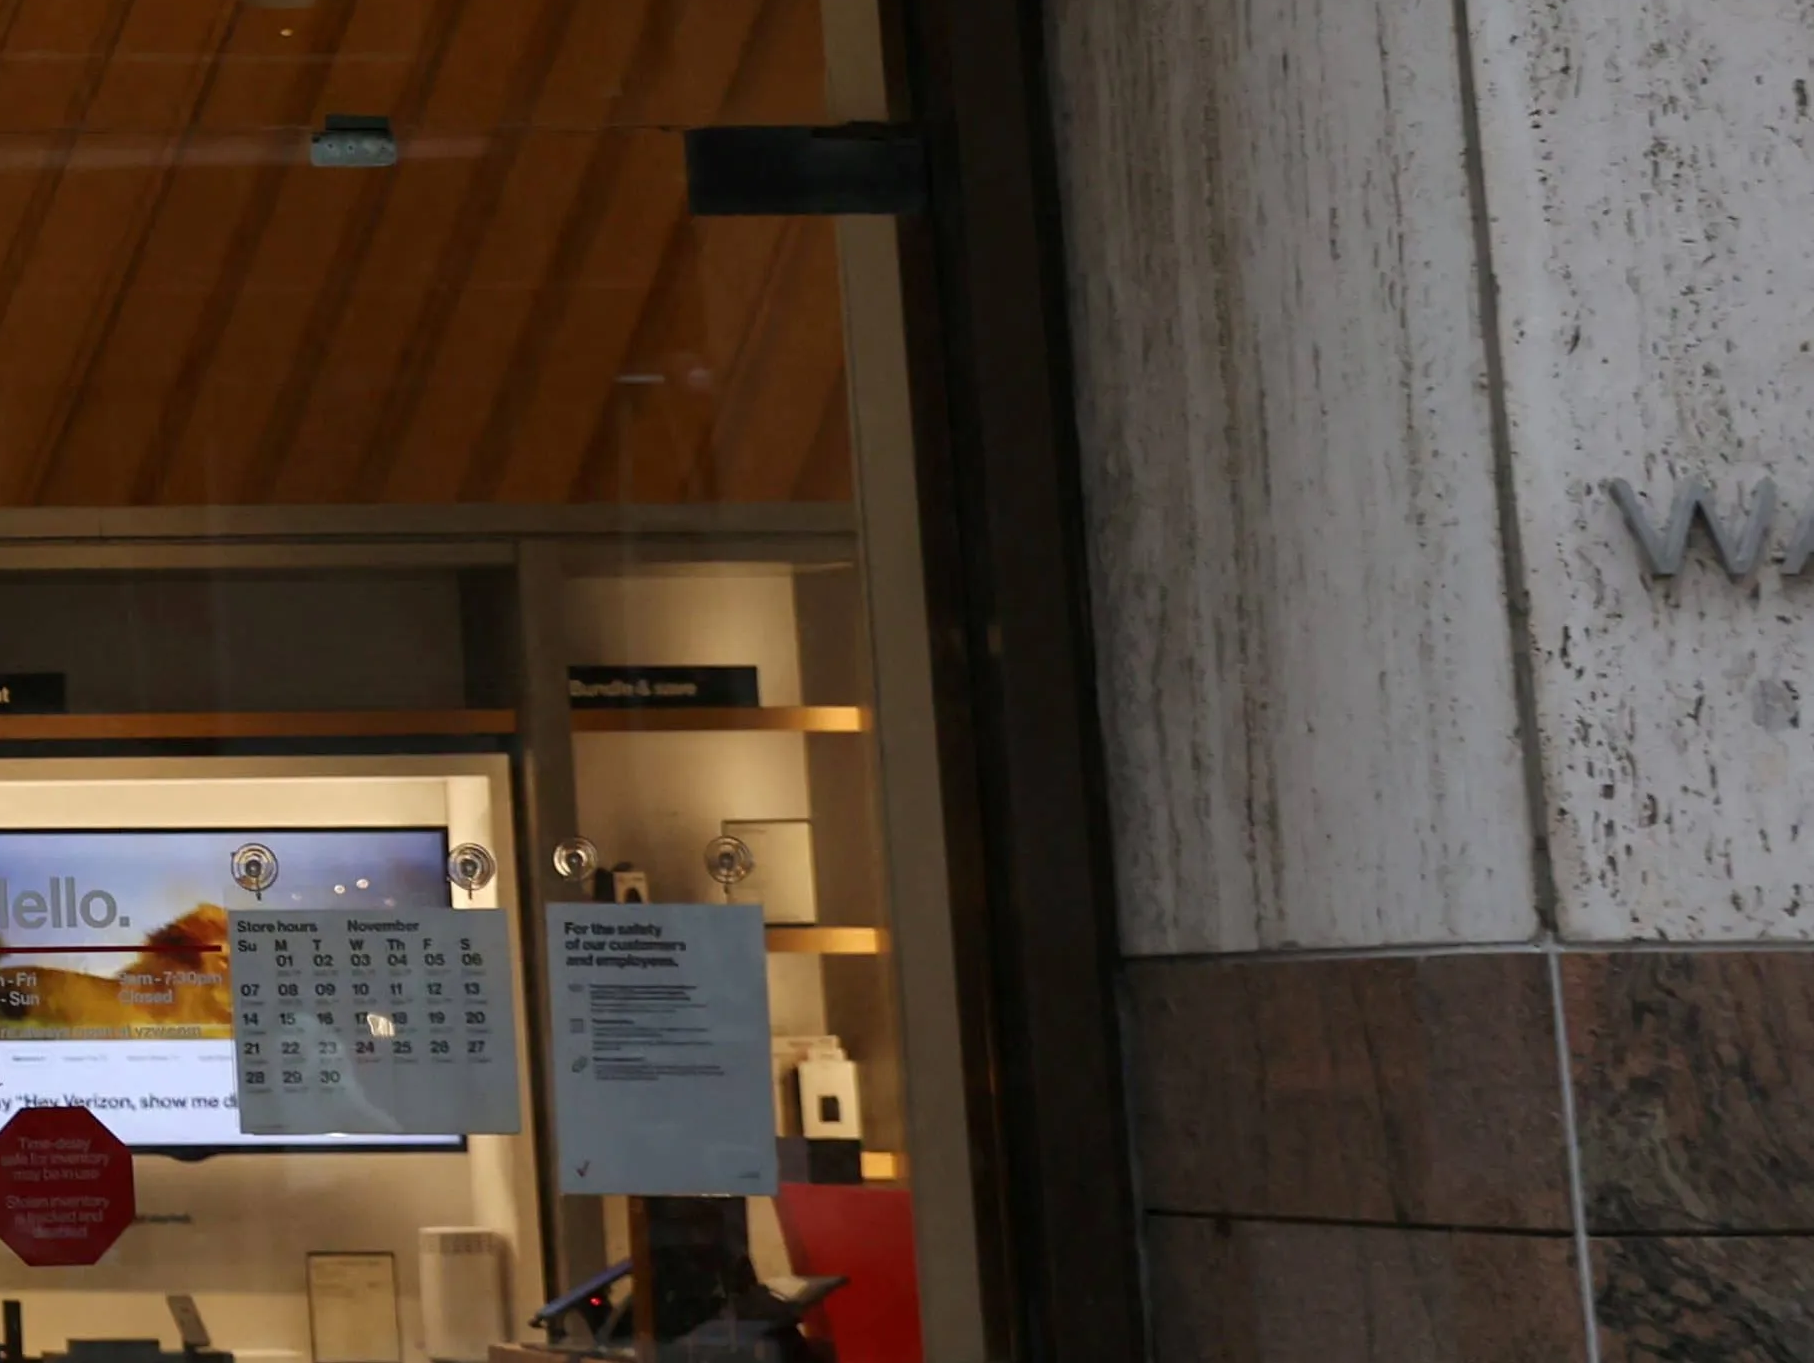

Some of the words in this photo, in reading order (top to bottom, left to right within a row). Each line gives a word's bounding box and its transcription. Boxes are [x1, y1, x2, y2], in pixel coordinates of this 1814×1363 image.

[236, 920, 275, 933] Store
[277, 920, 318, 933] hours
[347, 920, 420, 933] November
[564, 922, 590, 936] For
[591, 922, 615, 936] the
[618, 923, 662, 938] safety
[237, 939, 257, 952] Su
[275, 939, 288, 952] M
[312, 939, 322, 952] T
[349, 939, 364, 952] W
[386, 939, 406, 952] Th
[423, 939, 433, 952] F
[460, 939, 471, 952] S
[565, 938, 580, 951] of
[583, 941, 606, 951] our
[609, 939, 686, 952] customers
[276, 954, 294, 967] 01
[313, 954, 333, 967] 02
[350, 954, 371, 967] 03
[387, 954, 408, 967] 04
[424, 954, 446, 967] 05
[461, 954, 483, 967] 06
[566, 955, 593, 967] and
[17, 973, 38, 987] Fri
[240, 983, 260, 996] 07
[278, 983, 299, 996] 08
[314, 983, 336, 996] 09
[352, 983, 370, 996] 10
[390, 983, 404, 996] 11
[427, 983, 443, 996] 12
[464, 983, 481, 996] 13
[9, 992, 40, 1006] Sun
[243, 1012, 259, 1025] 14
[280, 1012, 296, 1025] 15
[316, 1012, 334, 1025] 16
[428, 1012, 446, 1025] 19
[465, 1012, 486, 1025] 20
[244, 1041, 260, 1054] 21
[281, 1041, 301, 1054] 22
[318, 1041, 339, 1054] 23
[355, 1041, 375, 1054] 24
[393, 1041, 413, 1054] 25
[467, 1041, 486, 1054] 27
[246, 1071, 265, 1084] 28
[283, 1071, 303, 1084] 29
[320, 1071, 341, 1084] 30
[139, 1093, 187, 1108] show
[191, 1096, 219, 1108] me
